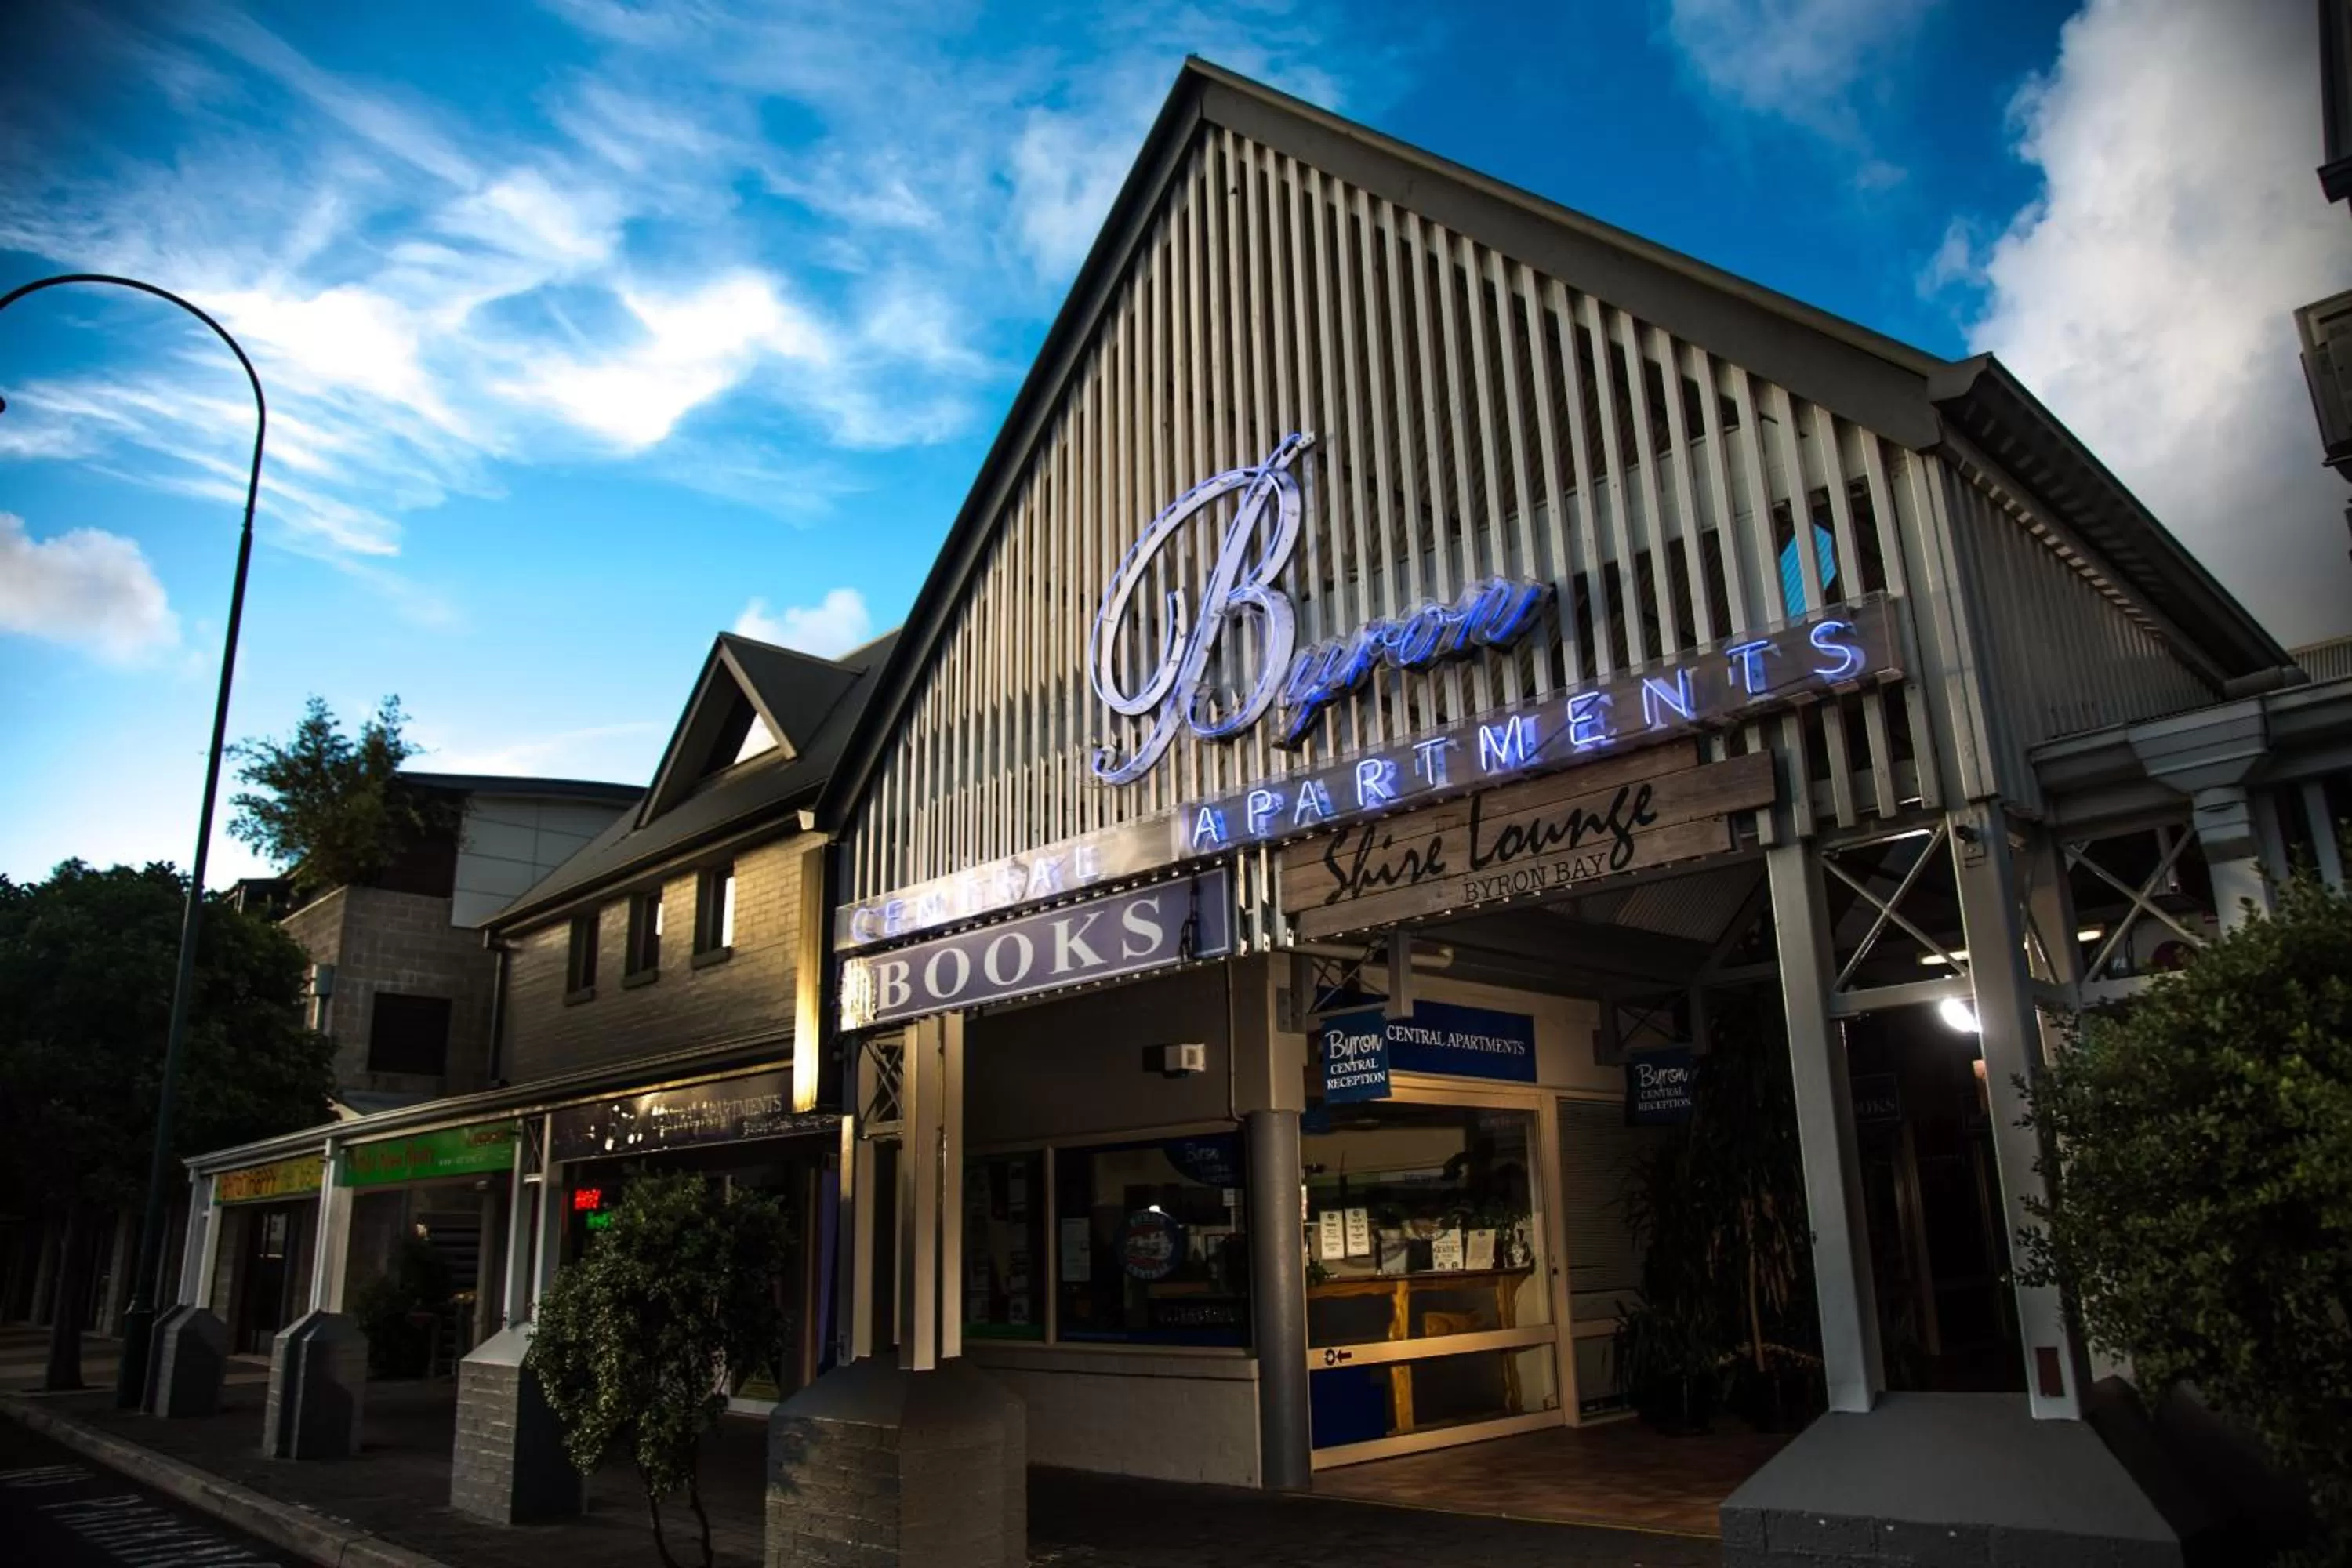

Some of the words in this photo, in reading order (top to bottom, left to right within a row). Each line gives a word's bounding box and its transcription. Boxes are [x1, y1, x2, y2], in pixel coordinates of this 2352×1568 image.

[1090, 430, 1555, 786] Byron
[852, 845, 1102, 943] CENTRAL
[1192, 619, 1869, 849] APARTMENTS
[1324, 825, 1447, 906] Shire
[1468, 783, 1658, 871] Lounge
[1464, 865, 1548, 904] BYRON
[1554, 851, 1607, 884] BAY
[878, 898, 1163, 1009] BOOKS
[1325, 1030, 1382, 1065] Byron
[1386, 1025, 1444, 1046] CENTRAL
[1447, 1031, 1526, 1054] APARTMENTS
[1327, 1072, 1386, 1090] RECEPTION
[1330, 1058, 1378, 1074] CENTRAL
[1635, 1063, 1689, 1091] Byron
[1638, 1097, 1692, 1112] RECEPTION
[1640, 1086, 1682, 1099] CENTRAL
